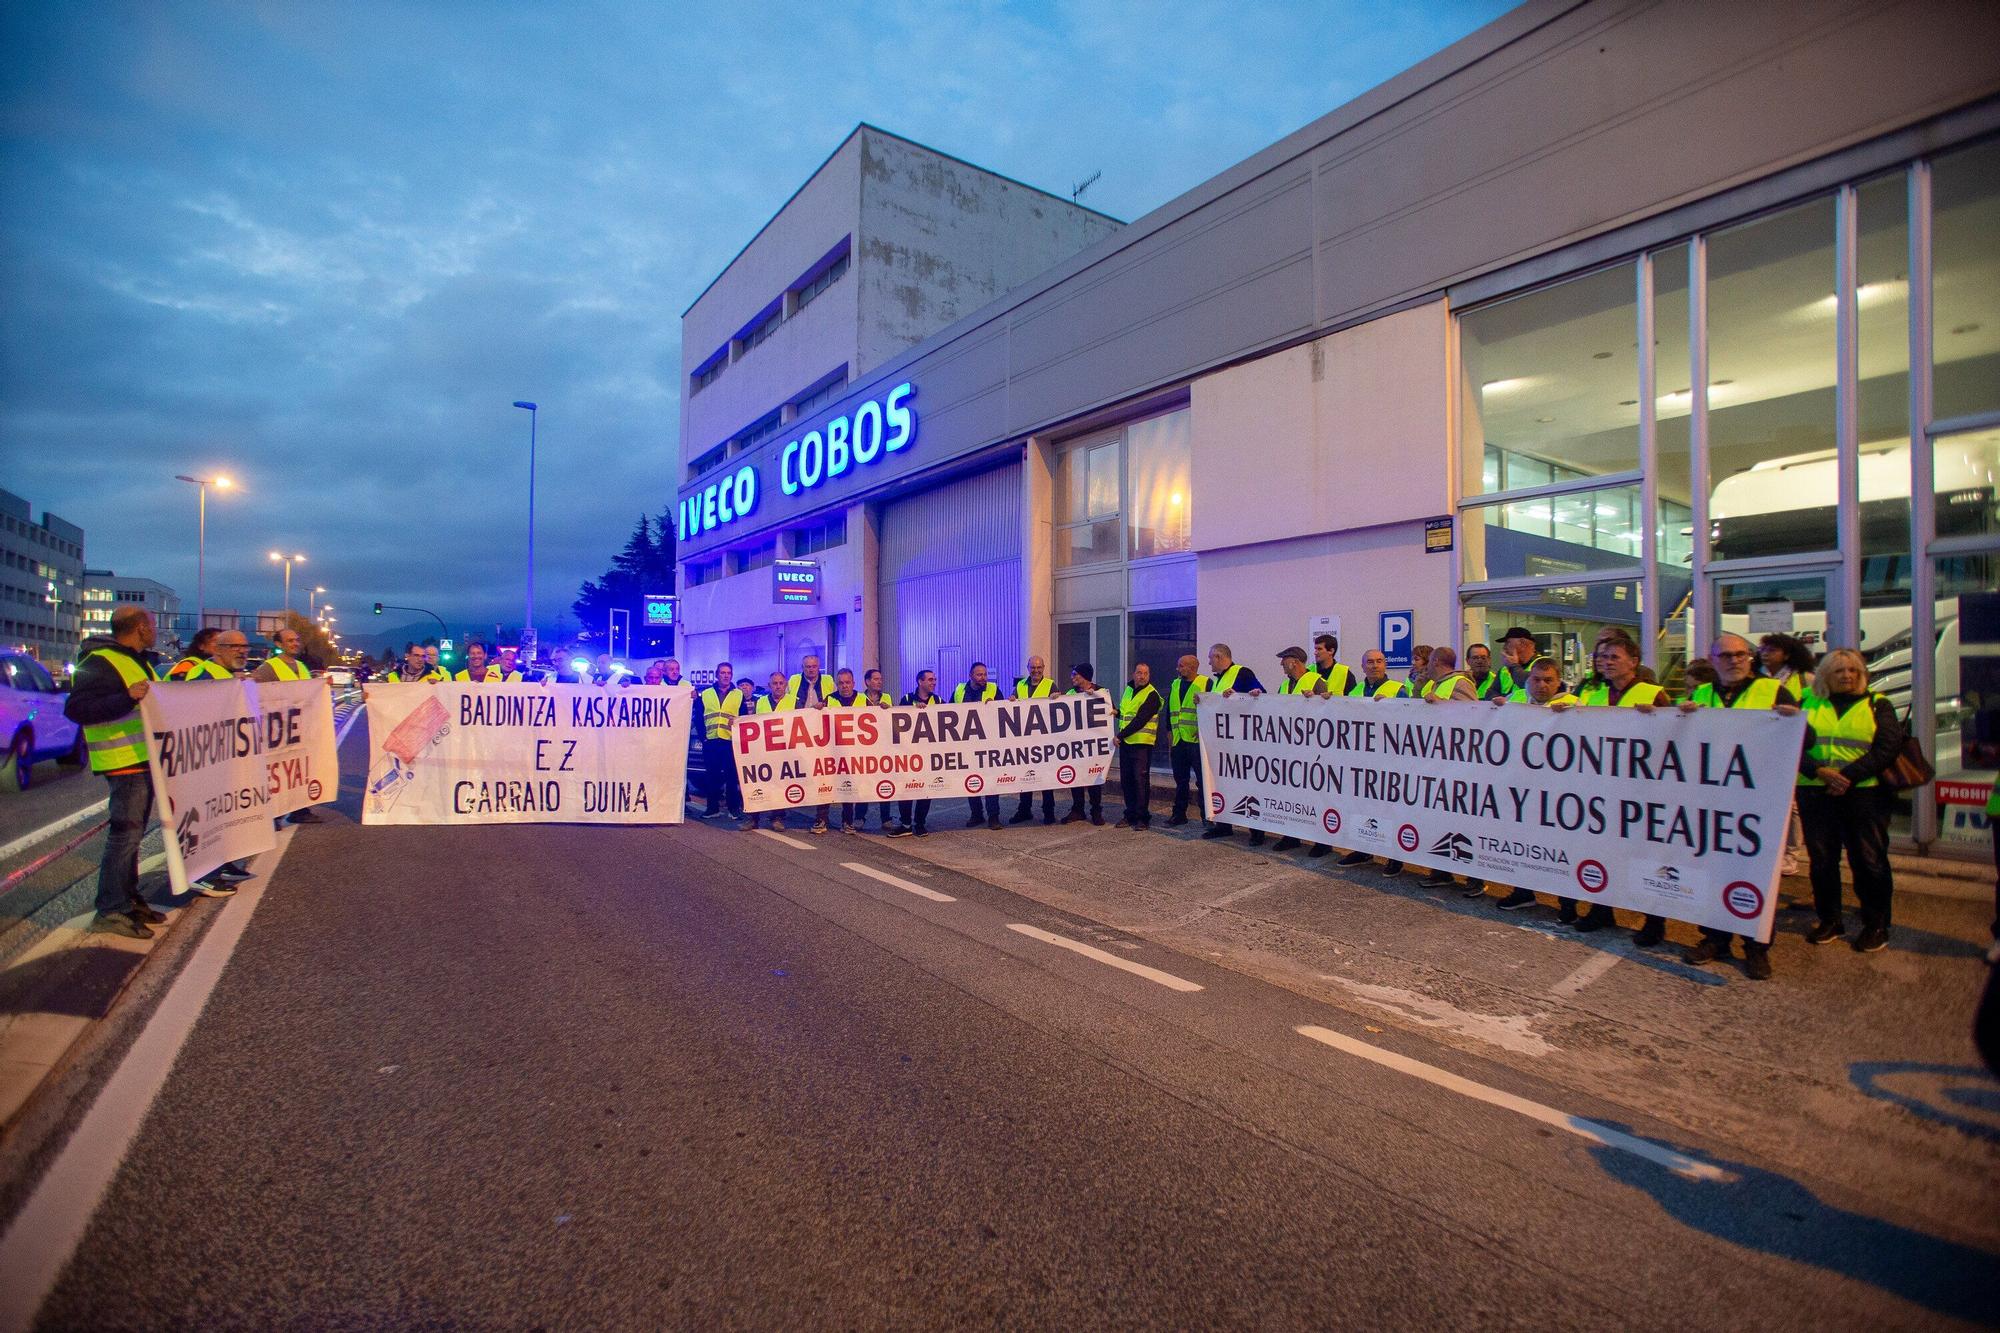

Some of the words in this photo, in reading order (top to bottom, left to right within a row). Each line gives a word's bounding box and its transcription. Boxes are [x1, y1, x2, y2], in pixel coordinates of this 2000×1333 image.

[780, 382, 912, 496] COBOS
[678, 465, 756, 541] IVECO
[778, 572, 814, 583] IVECO
[648, 602, 672, 614] OK
[784, 594, 808, 602] PARTS
[1384, 617, 1409, 651] P
[691, 670, 716, 683] COBO
[460, 694, 557, 728] BALDINTZA
[572, 696, 672, 728] KASKARRIK
[738, 712, 879, 755] PEAJES
[891, 709, 987, 744] PARA
[997, 697, 1108, 739] NADIE
[267, 708, 301, 749] DE
[536, 739, 578, 771] EZ
[742, 763, 773, 784] NO
[780, 760, 807, 780] AL
[813, 754, 924, 777] ABANDONO
[930, 752, 969, 771] DEL
[974, 738, 1110, 769] TRANSPORTE
[1215, 713, 1235, 740] EL
[1239, 714, 1376, 753] TRANSPORTE
[1383, 722, 1511, 767] NAVARRO
[1521, 731, 1687, 783] CONTRA
[1700, 742, 1756, 790] LA
[905, 780, 925, 789] HIRU
[996, 774, 1016, 783] HIRU
[454, 780, 561, 814] GARRAIO
[584, 781, 649, 813] DUINA
[1218, 752, 1344, 795] IMPOSICIÓN
[1351, 767, 1501, 820] TRIBUTARIA
[1508, 786, 1530, 823] Y
[1540, 790, 1607, 835] LOS
[1619, 799, 1762, 857] PEAJES
[1954, 811, 1992, 829] IV
